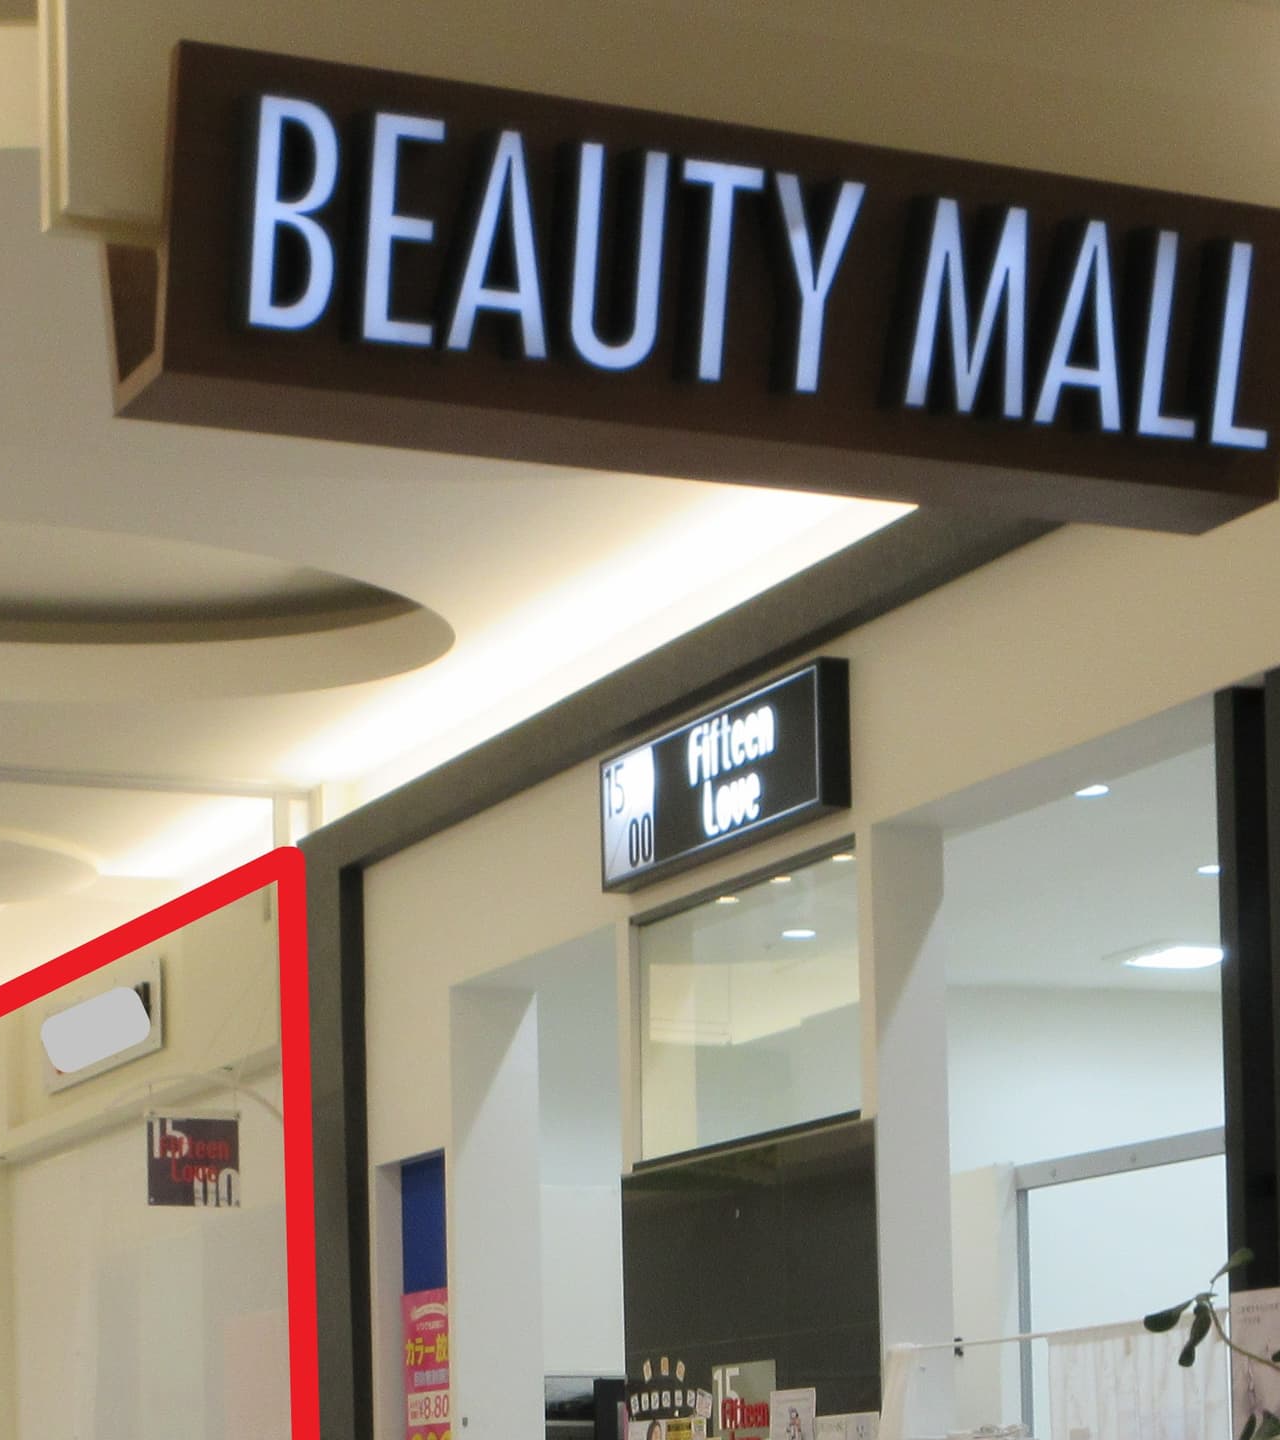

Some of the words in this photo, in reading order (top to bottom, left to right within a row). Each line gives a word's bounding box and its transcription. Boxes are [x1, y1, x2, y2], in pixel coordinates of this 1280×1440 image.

[246, 93, 866, 393] BEAUTY
[904, 196, 1269, 450] MALL
[687, 704, 776, 788] Fifteen
[702, 771, 761, 839] Love
